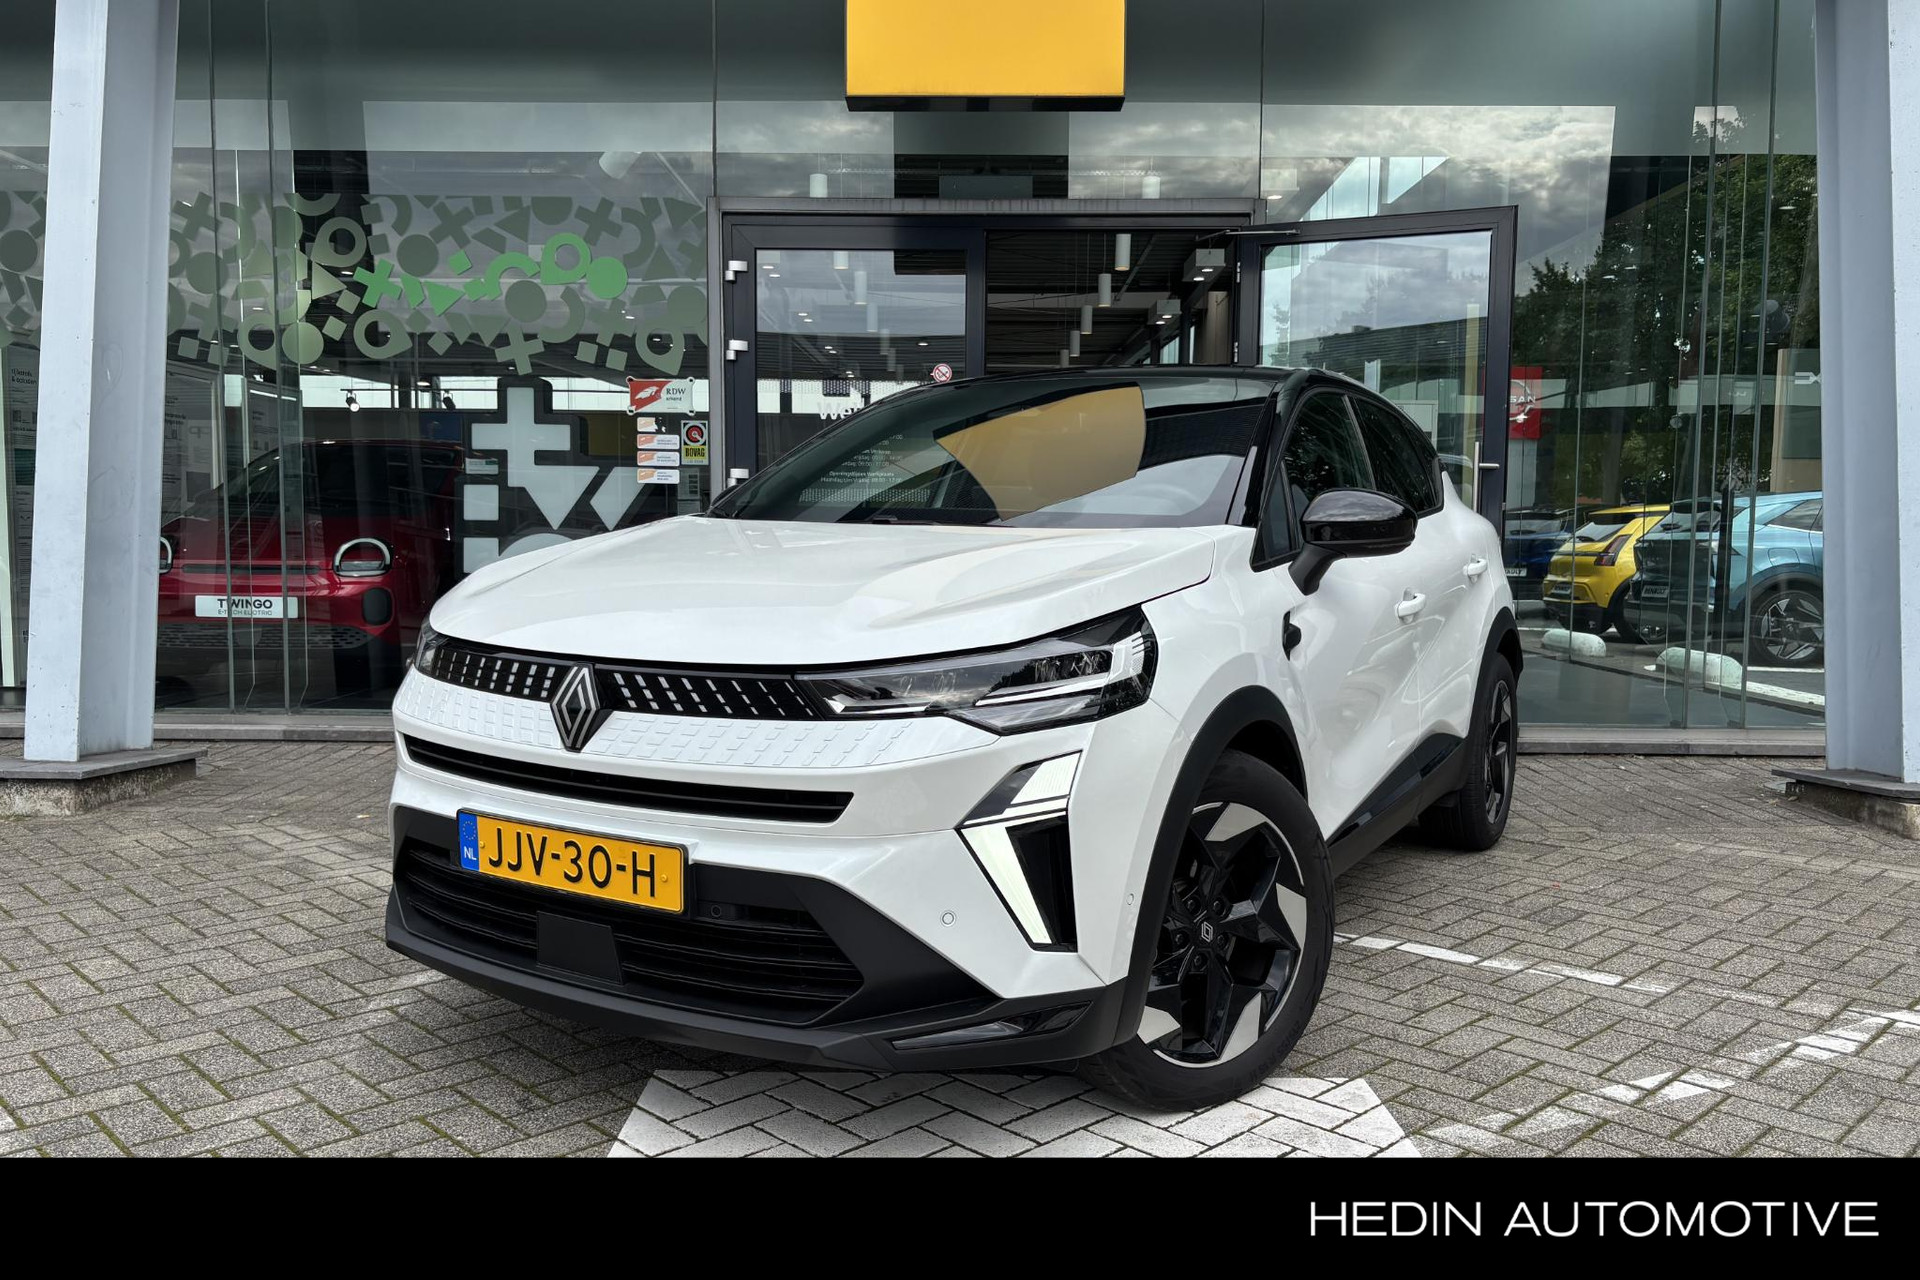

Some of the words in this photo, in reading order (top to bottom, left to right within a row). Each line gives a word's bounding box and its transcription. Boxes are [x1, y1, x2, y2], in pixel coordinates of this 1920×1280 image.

[666, 387, 686, 395] RDW
[685, 447, 705, 457] BOVAG
[216, 598, 273, 609] TWINGO
[463, 845, 477, 861] NL
[488, 827, 656, 898] JJV-30-H
